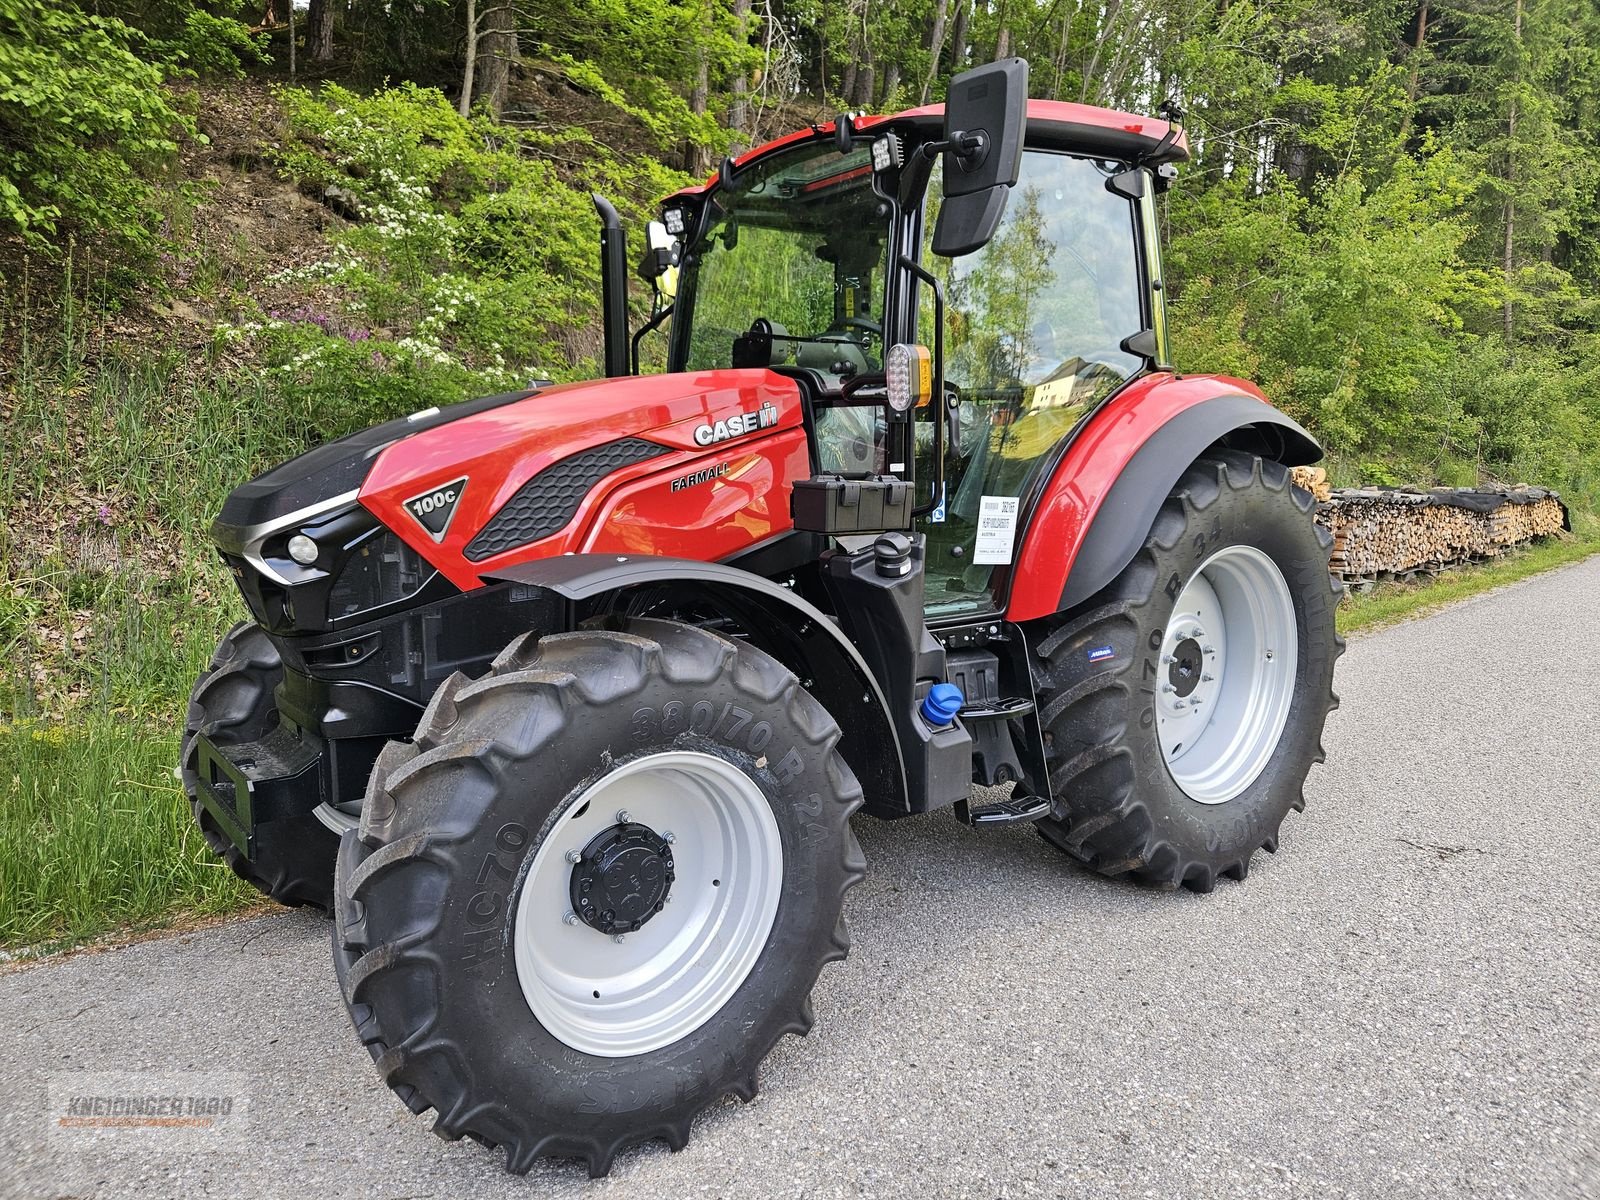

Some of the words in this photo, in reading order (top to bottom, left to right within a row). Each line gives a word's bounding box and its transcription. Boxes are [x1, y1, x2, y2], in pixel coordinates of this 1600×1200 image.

[694, 412, 757, 446] CASE
[671, 462, 730, 494] FARMALL
[632, 700, 773, 752] 380/70
[772, 745, 806, 786] R
[792, 792, 830, 848] 24
